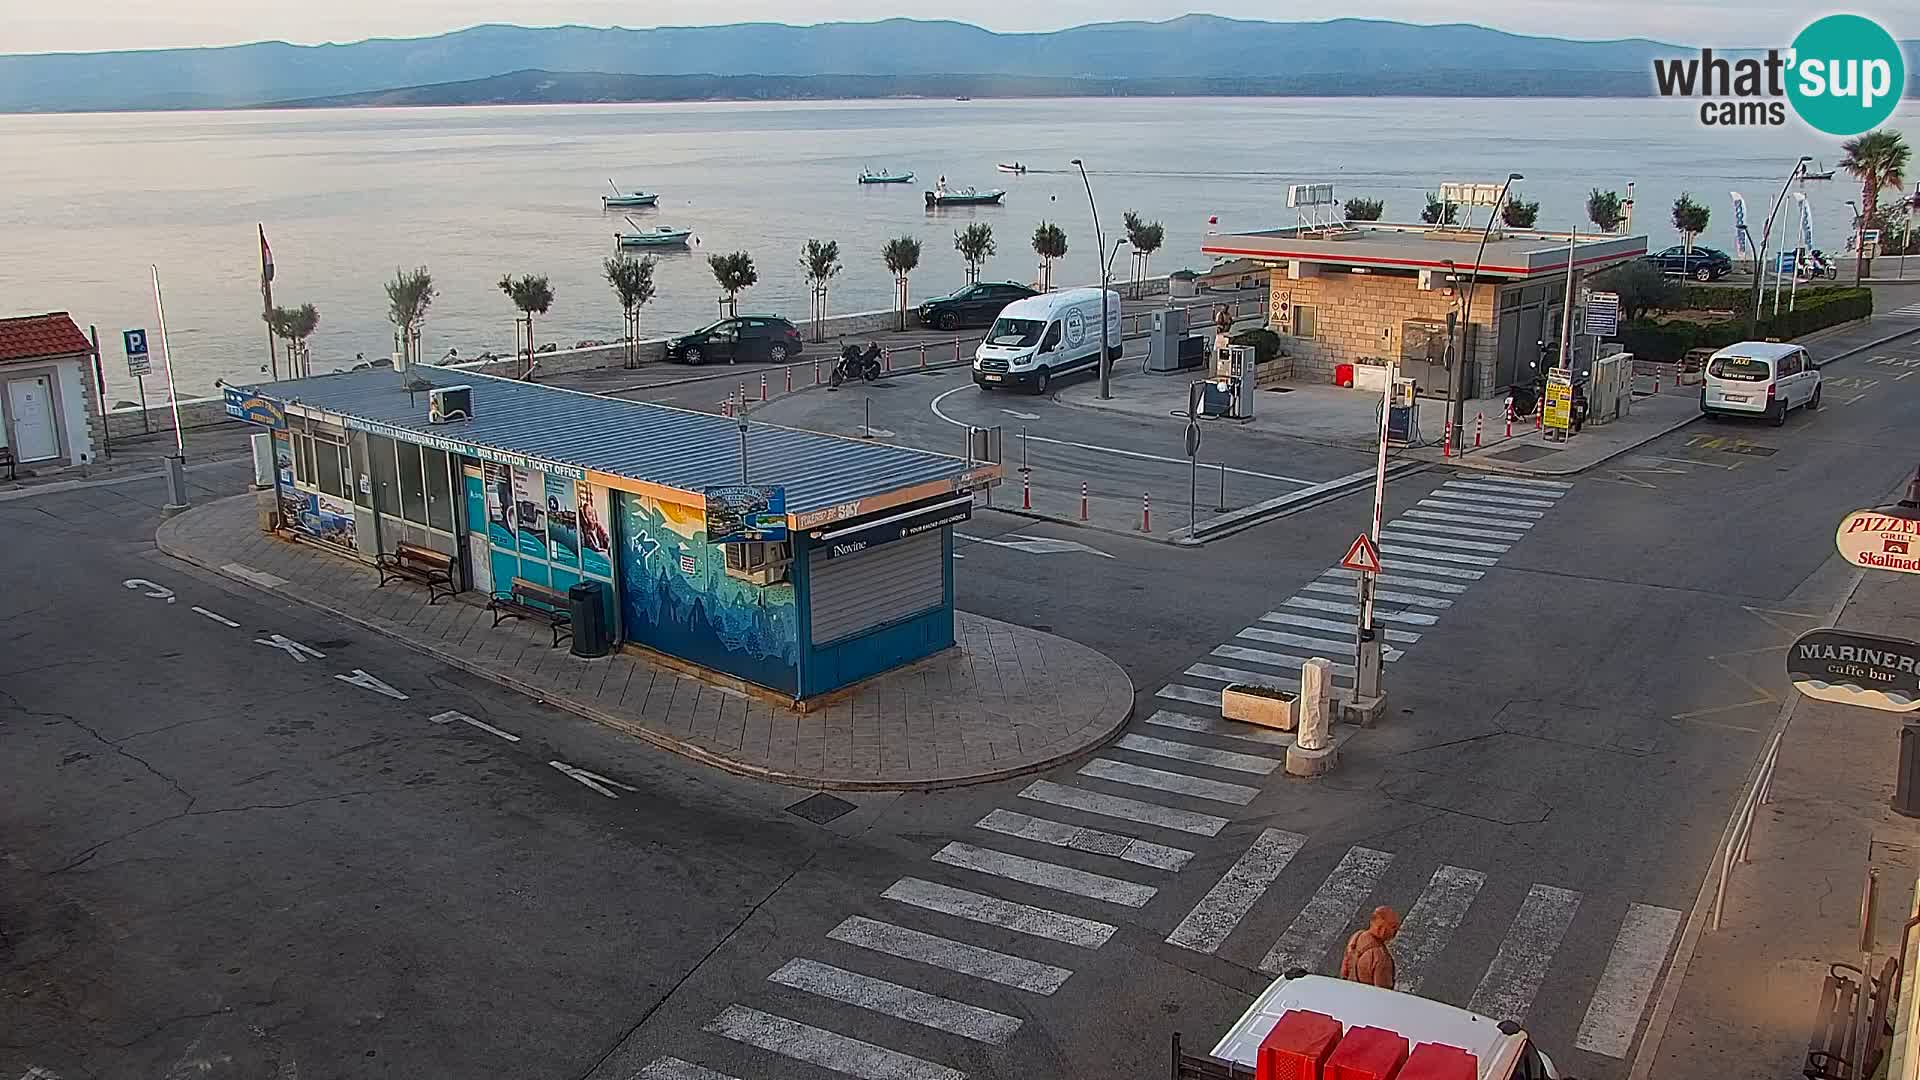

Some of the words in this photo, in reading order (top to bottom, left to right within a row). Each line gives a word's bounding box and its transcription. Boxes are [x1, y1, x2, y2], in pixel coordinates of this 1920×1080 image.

[129, 333, 142, 352] P
[1732, 357, 1750, 366] TAXI
[394, 429, 436, 447] AUTOBUSNA
[435, 439, 467, 454] POSTAJA
[477, 448, 492, 459] BUS
[493, 451, 525, 467] STATION
[528, 459, 553, 474] TICKET
[554, 465, 582, 479] OFFICE
[1880, 532, 1915, 542] GRILL
[833, 541, 867, 557] iNovine
[1828, 664, 1865, 677] caffe
[1869, 667, 1896, 681] bar
